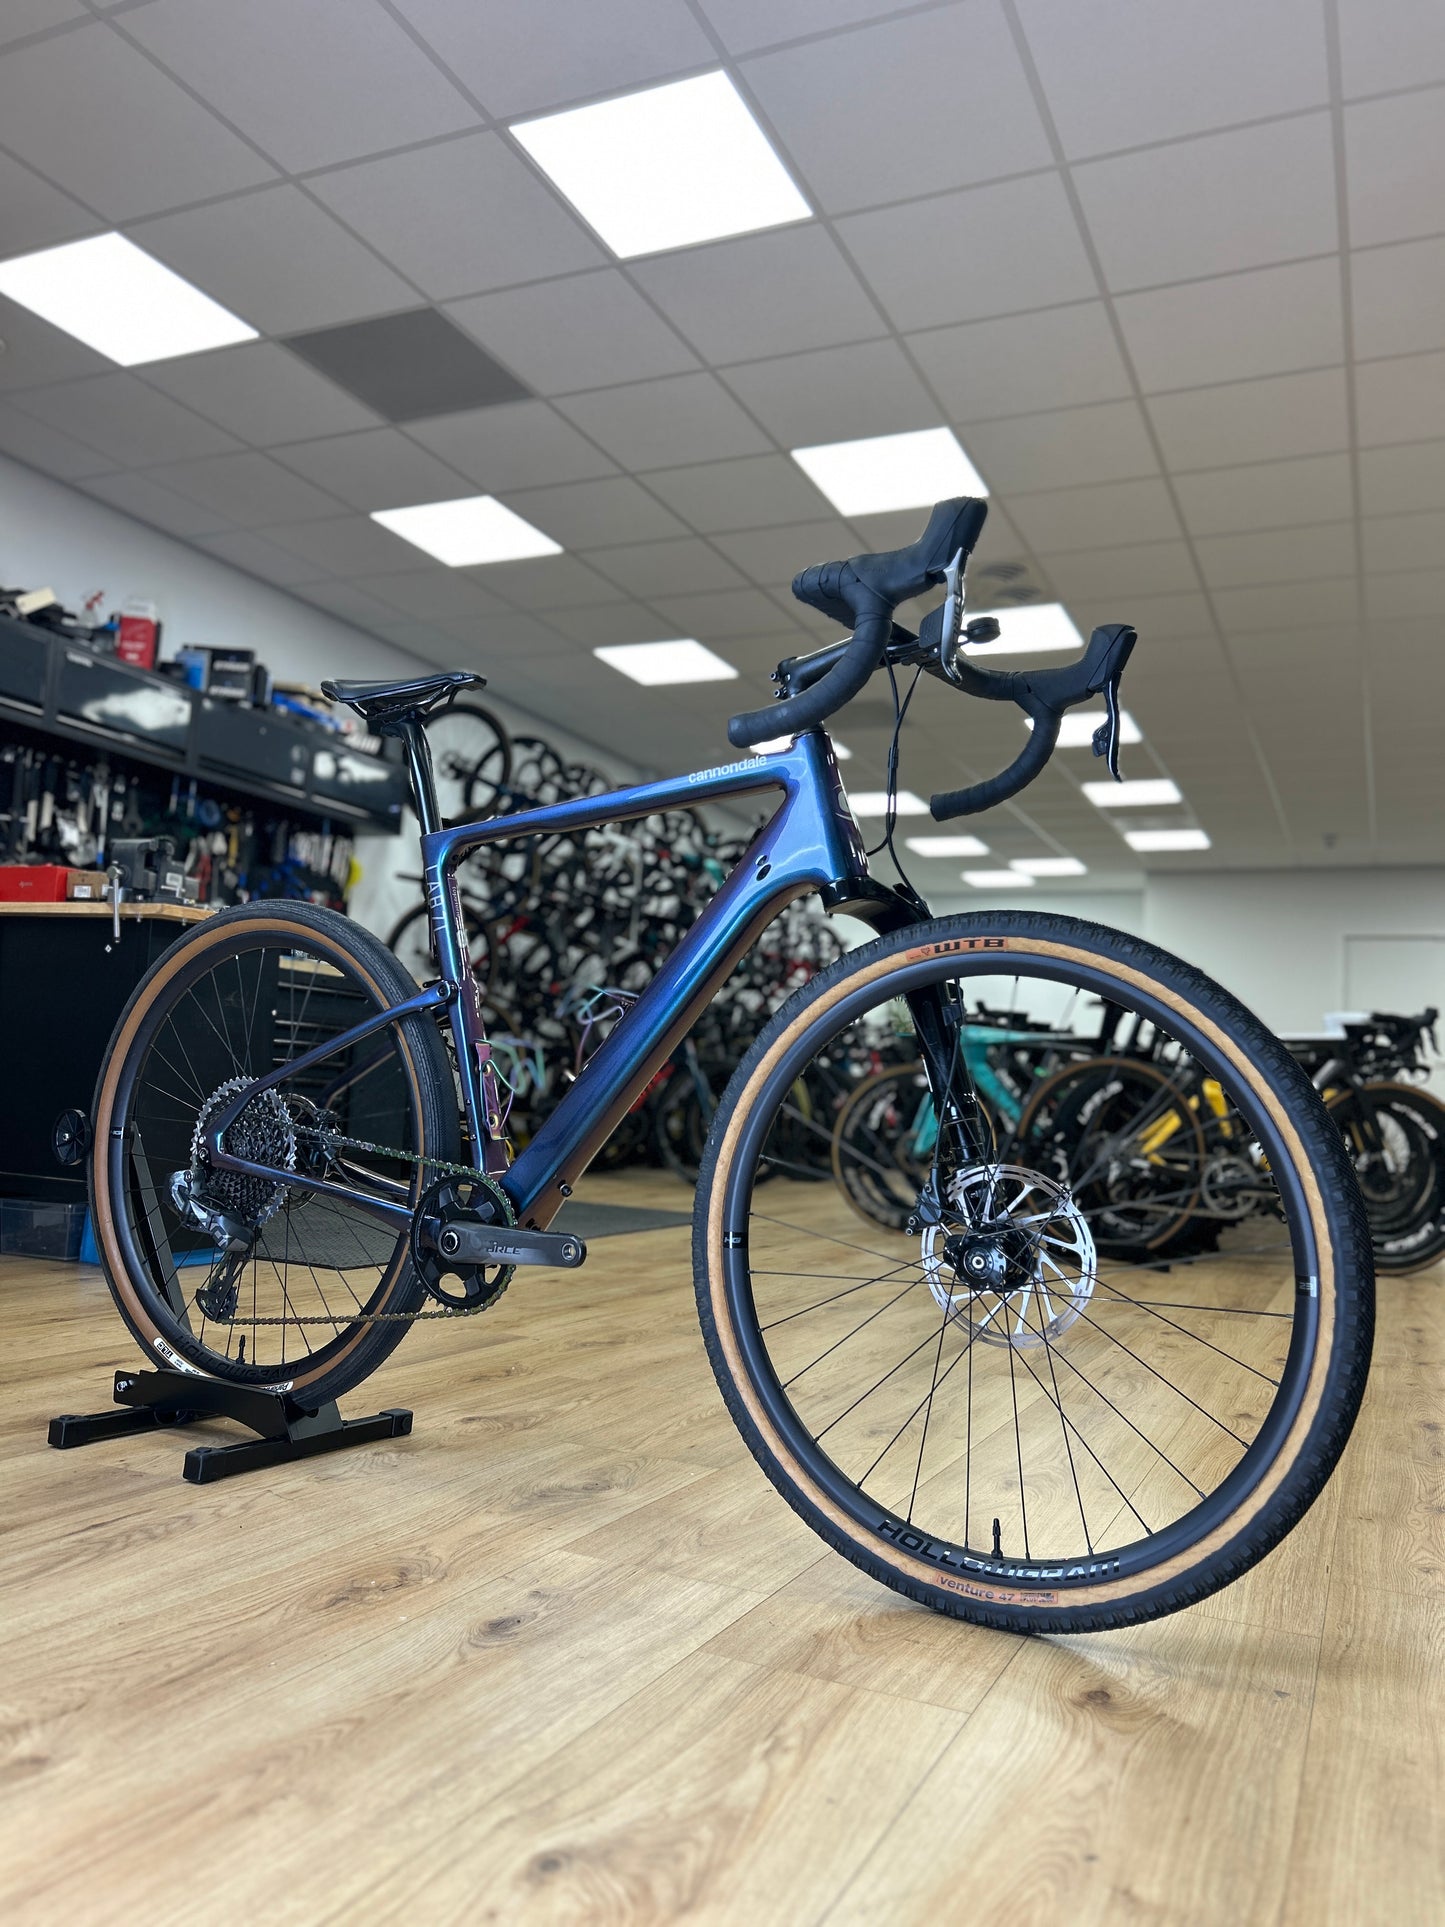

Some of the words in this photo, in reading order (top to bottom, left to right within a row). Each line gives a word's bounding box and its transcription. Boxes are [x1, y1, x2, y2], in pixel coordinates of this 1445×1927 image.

[688, 755, 767, 783] cannondale
[934, 938, 1004, 954] WTB
[486, 1241, 521, 1255] ORCE
[876, 1519, 1120, 1582] HOLLOWGRAM
[940, 1576, 995, 1600] venture
[998, 1592, 1015, 1602] 47
